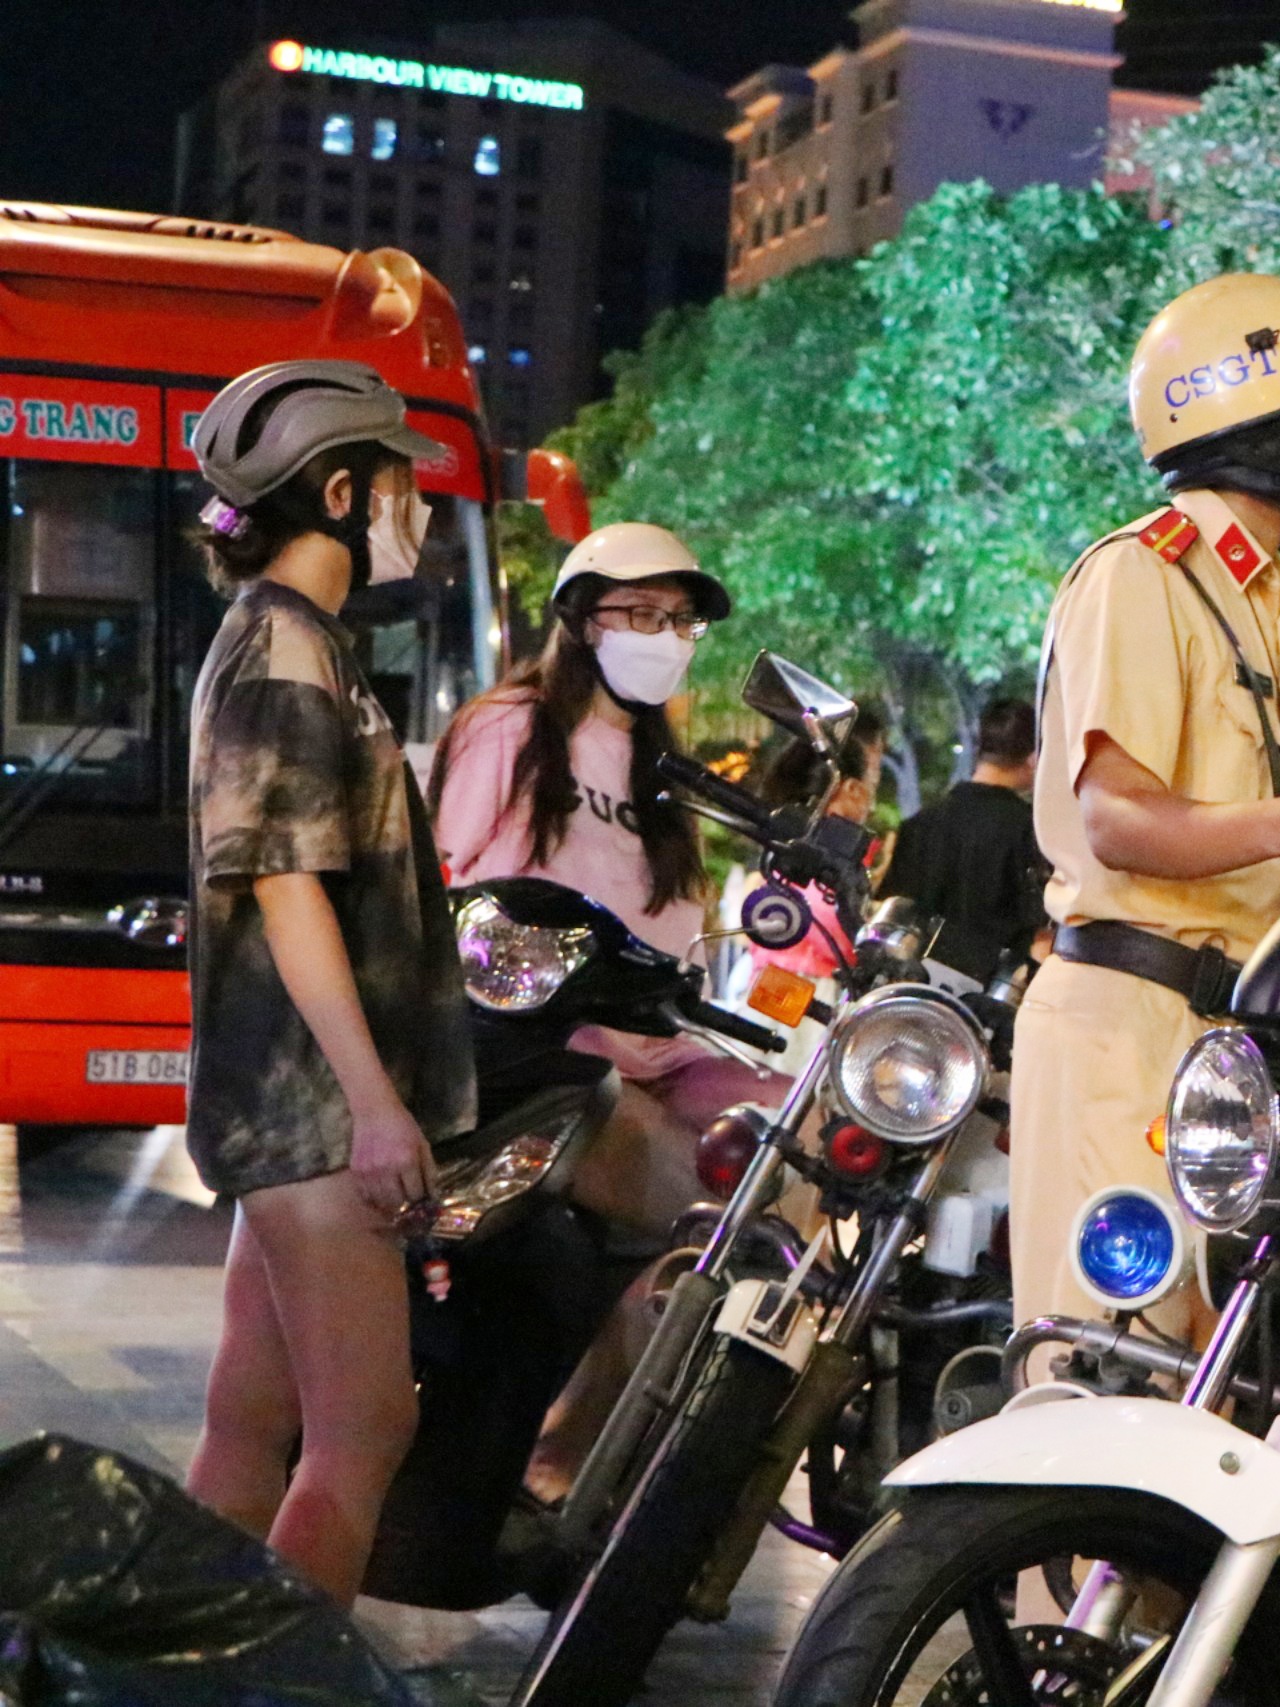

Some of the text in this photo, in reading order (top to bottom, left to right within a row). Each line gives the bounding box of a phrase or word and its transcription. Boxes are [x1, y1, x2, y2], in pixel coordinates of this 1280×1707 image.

[303, 46, 584, 110] HARBOUR VIEW TOWER
[1165, 349, 1277, 408] CSGT
[22, 399, 138, 446] TRANG
[92, 1052, 137, 1079] 51B
